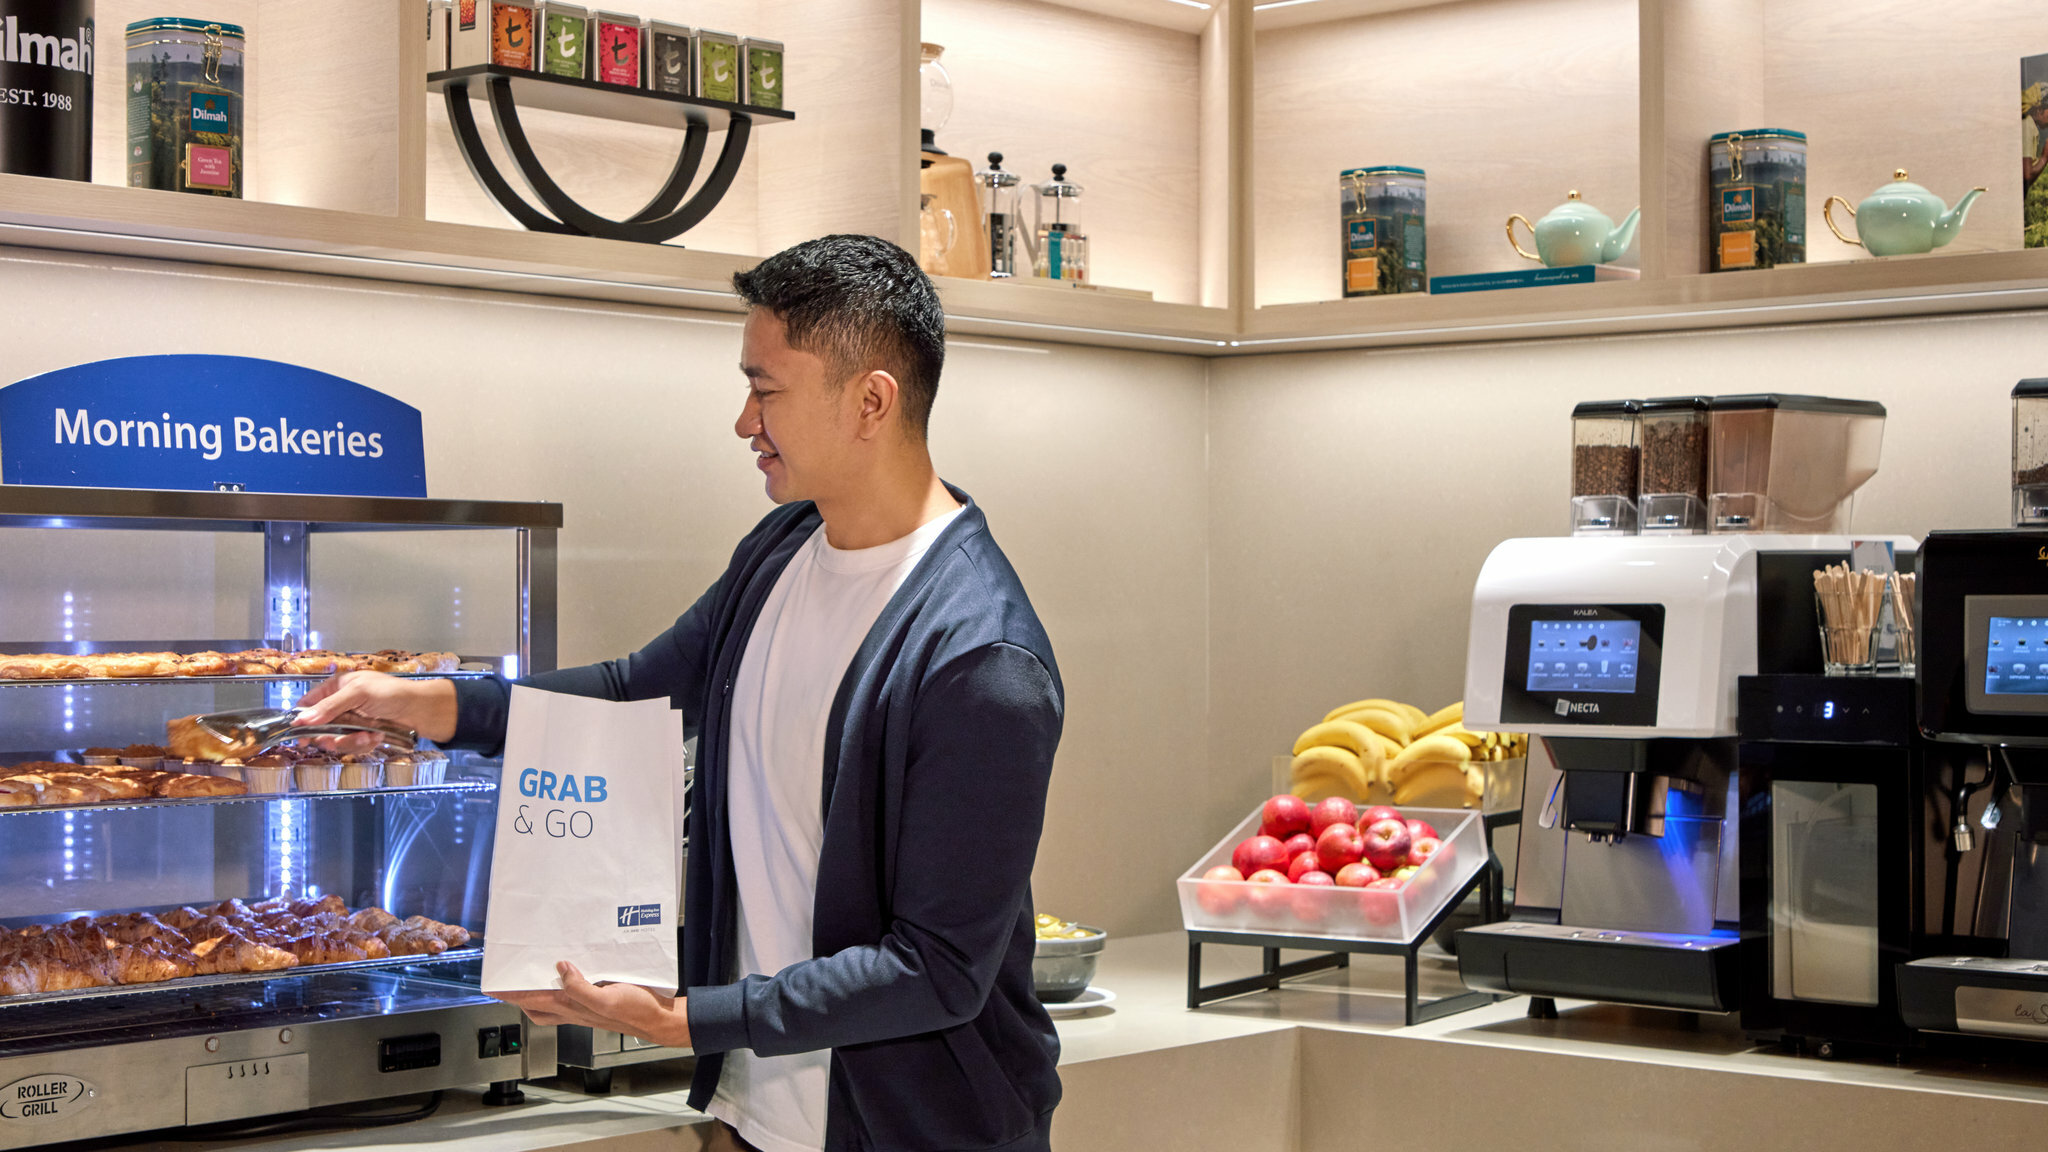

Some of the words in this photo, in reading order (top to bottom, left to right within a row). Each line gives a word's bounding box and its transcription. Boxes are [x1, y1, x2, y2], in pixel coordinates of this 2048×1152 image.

[41, 91, 72, 111] 1988
[193, 108, 227, 122] Dilmah
[1724, 202, 1751, 213] Dilmah
[55, 408, 222, 460] Morning
[234, 416, 384, 459] Bakeries
[1570, 703, 1600, 713] NECTA
[1824, 701, 1834, 719] 3
[519, 767, 608, 803] GRAB
[514, 804, 533, 835] &
[545, 809, 593, 839] GO
[18, 1081, 67, 1099] ROLLER
[22, 1101, 58, 1118] GRILL
